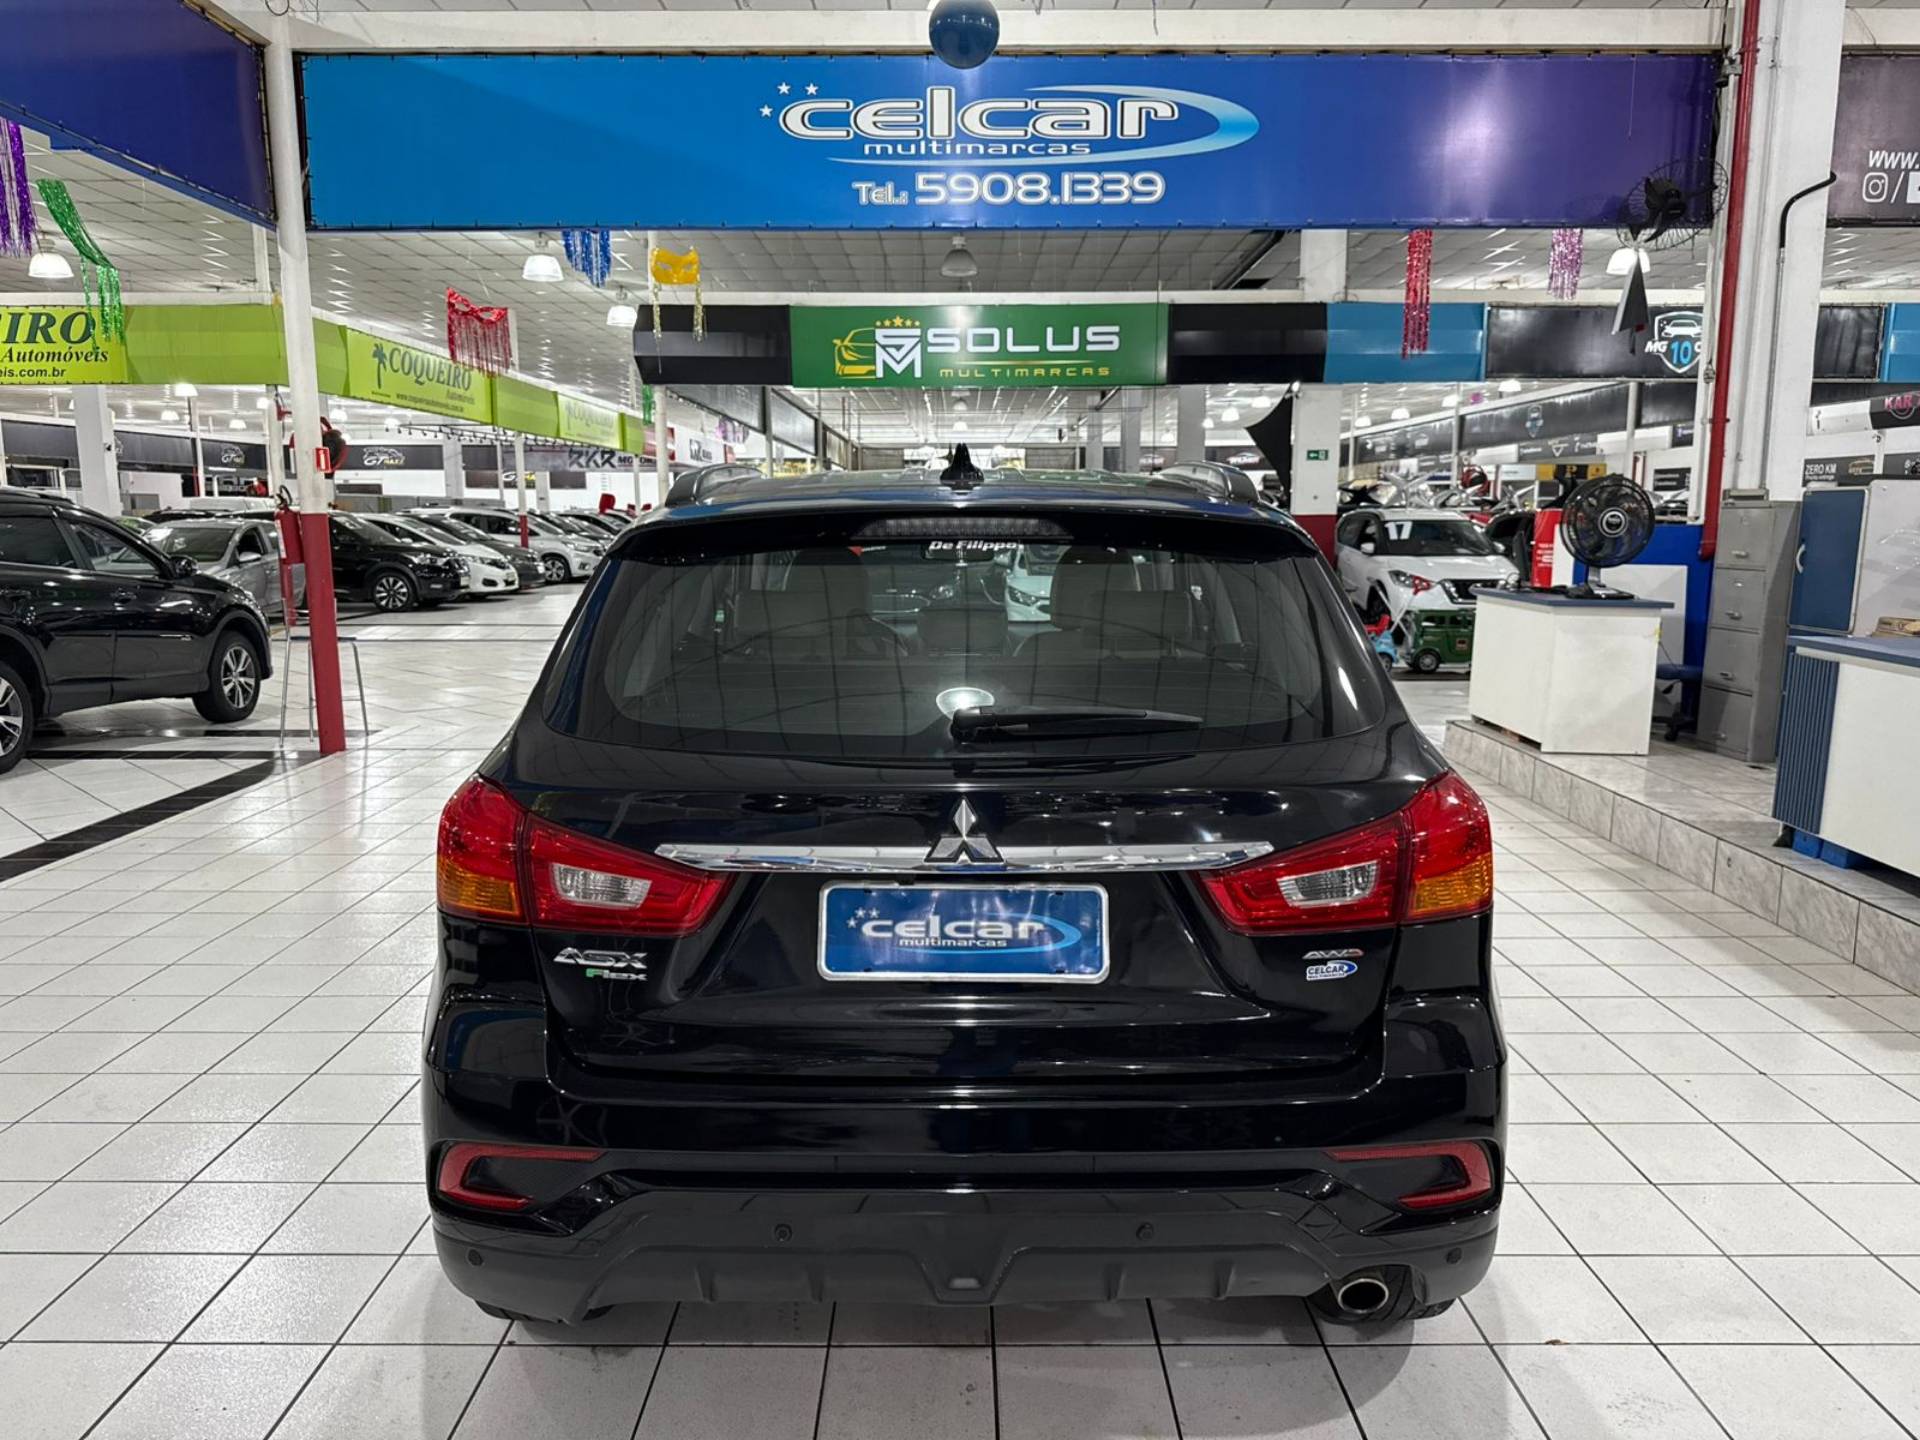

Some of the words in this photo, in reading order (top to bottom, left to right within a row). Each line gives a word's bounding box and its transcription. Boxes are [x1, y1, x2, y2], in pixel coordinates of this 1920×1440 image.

[779, 86, 1180, 139] celcar
[863, 141, 1092, 156] multimarcas
[915, 172, 1166, 206] 5908.1339
[0, 312, 96, 344] IRO
[927, 325, 1120, 352] SOLUS
[2, 346, 109, 363] Automóveis
[1645, 341, 1668, 353] MG
[1671, 341, 1692, 364] 10
[390, 348, 472, 391] COQUEIRO
[940, 367, 1110, 378] MULTIMARCAS
[1805, 464, 1824, 475] ZERO
[1825, 463, 1837, 474] KM
[1384, 521, 1413, 540] 17
[929, 541, 953, 550] De
[956, 540, 1017, 551] Filippo
[862, 915, 1045, 938] celcar
[899, 936, 1008, 948] multimarcas
[553, 947, 648, 969] ASX
[1307, 965, 1345, 975] CELCAR
